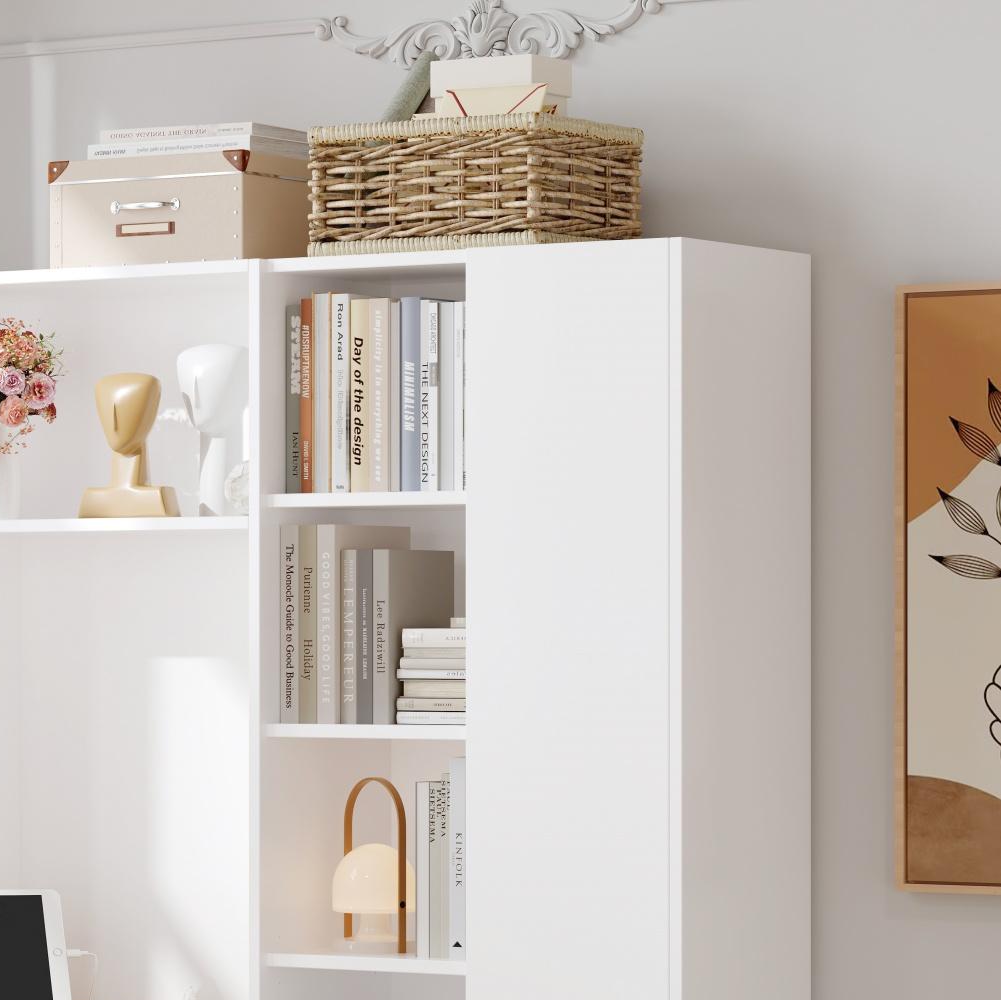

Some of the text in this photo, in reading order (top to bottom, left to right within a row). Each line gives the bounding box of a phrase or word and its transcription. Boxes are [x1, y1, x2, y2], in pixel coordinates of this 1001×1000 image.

[302, 325, 310, 399] #DISRUPTMENOW
[352, 337, 364, 466] Day of the design
[373, 390, 383, 445] everything
[403, 360, 415, 432] MINIMALISM
[421, 361, 429, 483] THE NEXT DESIGN
[285, 544, 294, 563] The
[321, 552, 330, 590] GOOD
[285, 564, 294, 602] Monocle
[285, 604, 294, 631] Guide
[285, 633, 293, 643] to
[300, 567, 314, 681] Purienne Holiday
[376, 600, 385, 674] Lee Radziwill
[285, 644, 294, 669] Good
[321, 634, 330, 672] GOOD
[321, 676, 330, 704] LIFE
[455, 832, 463, 888] KINFOLK
